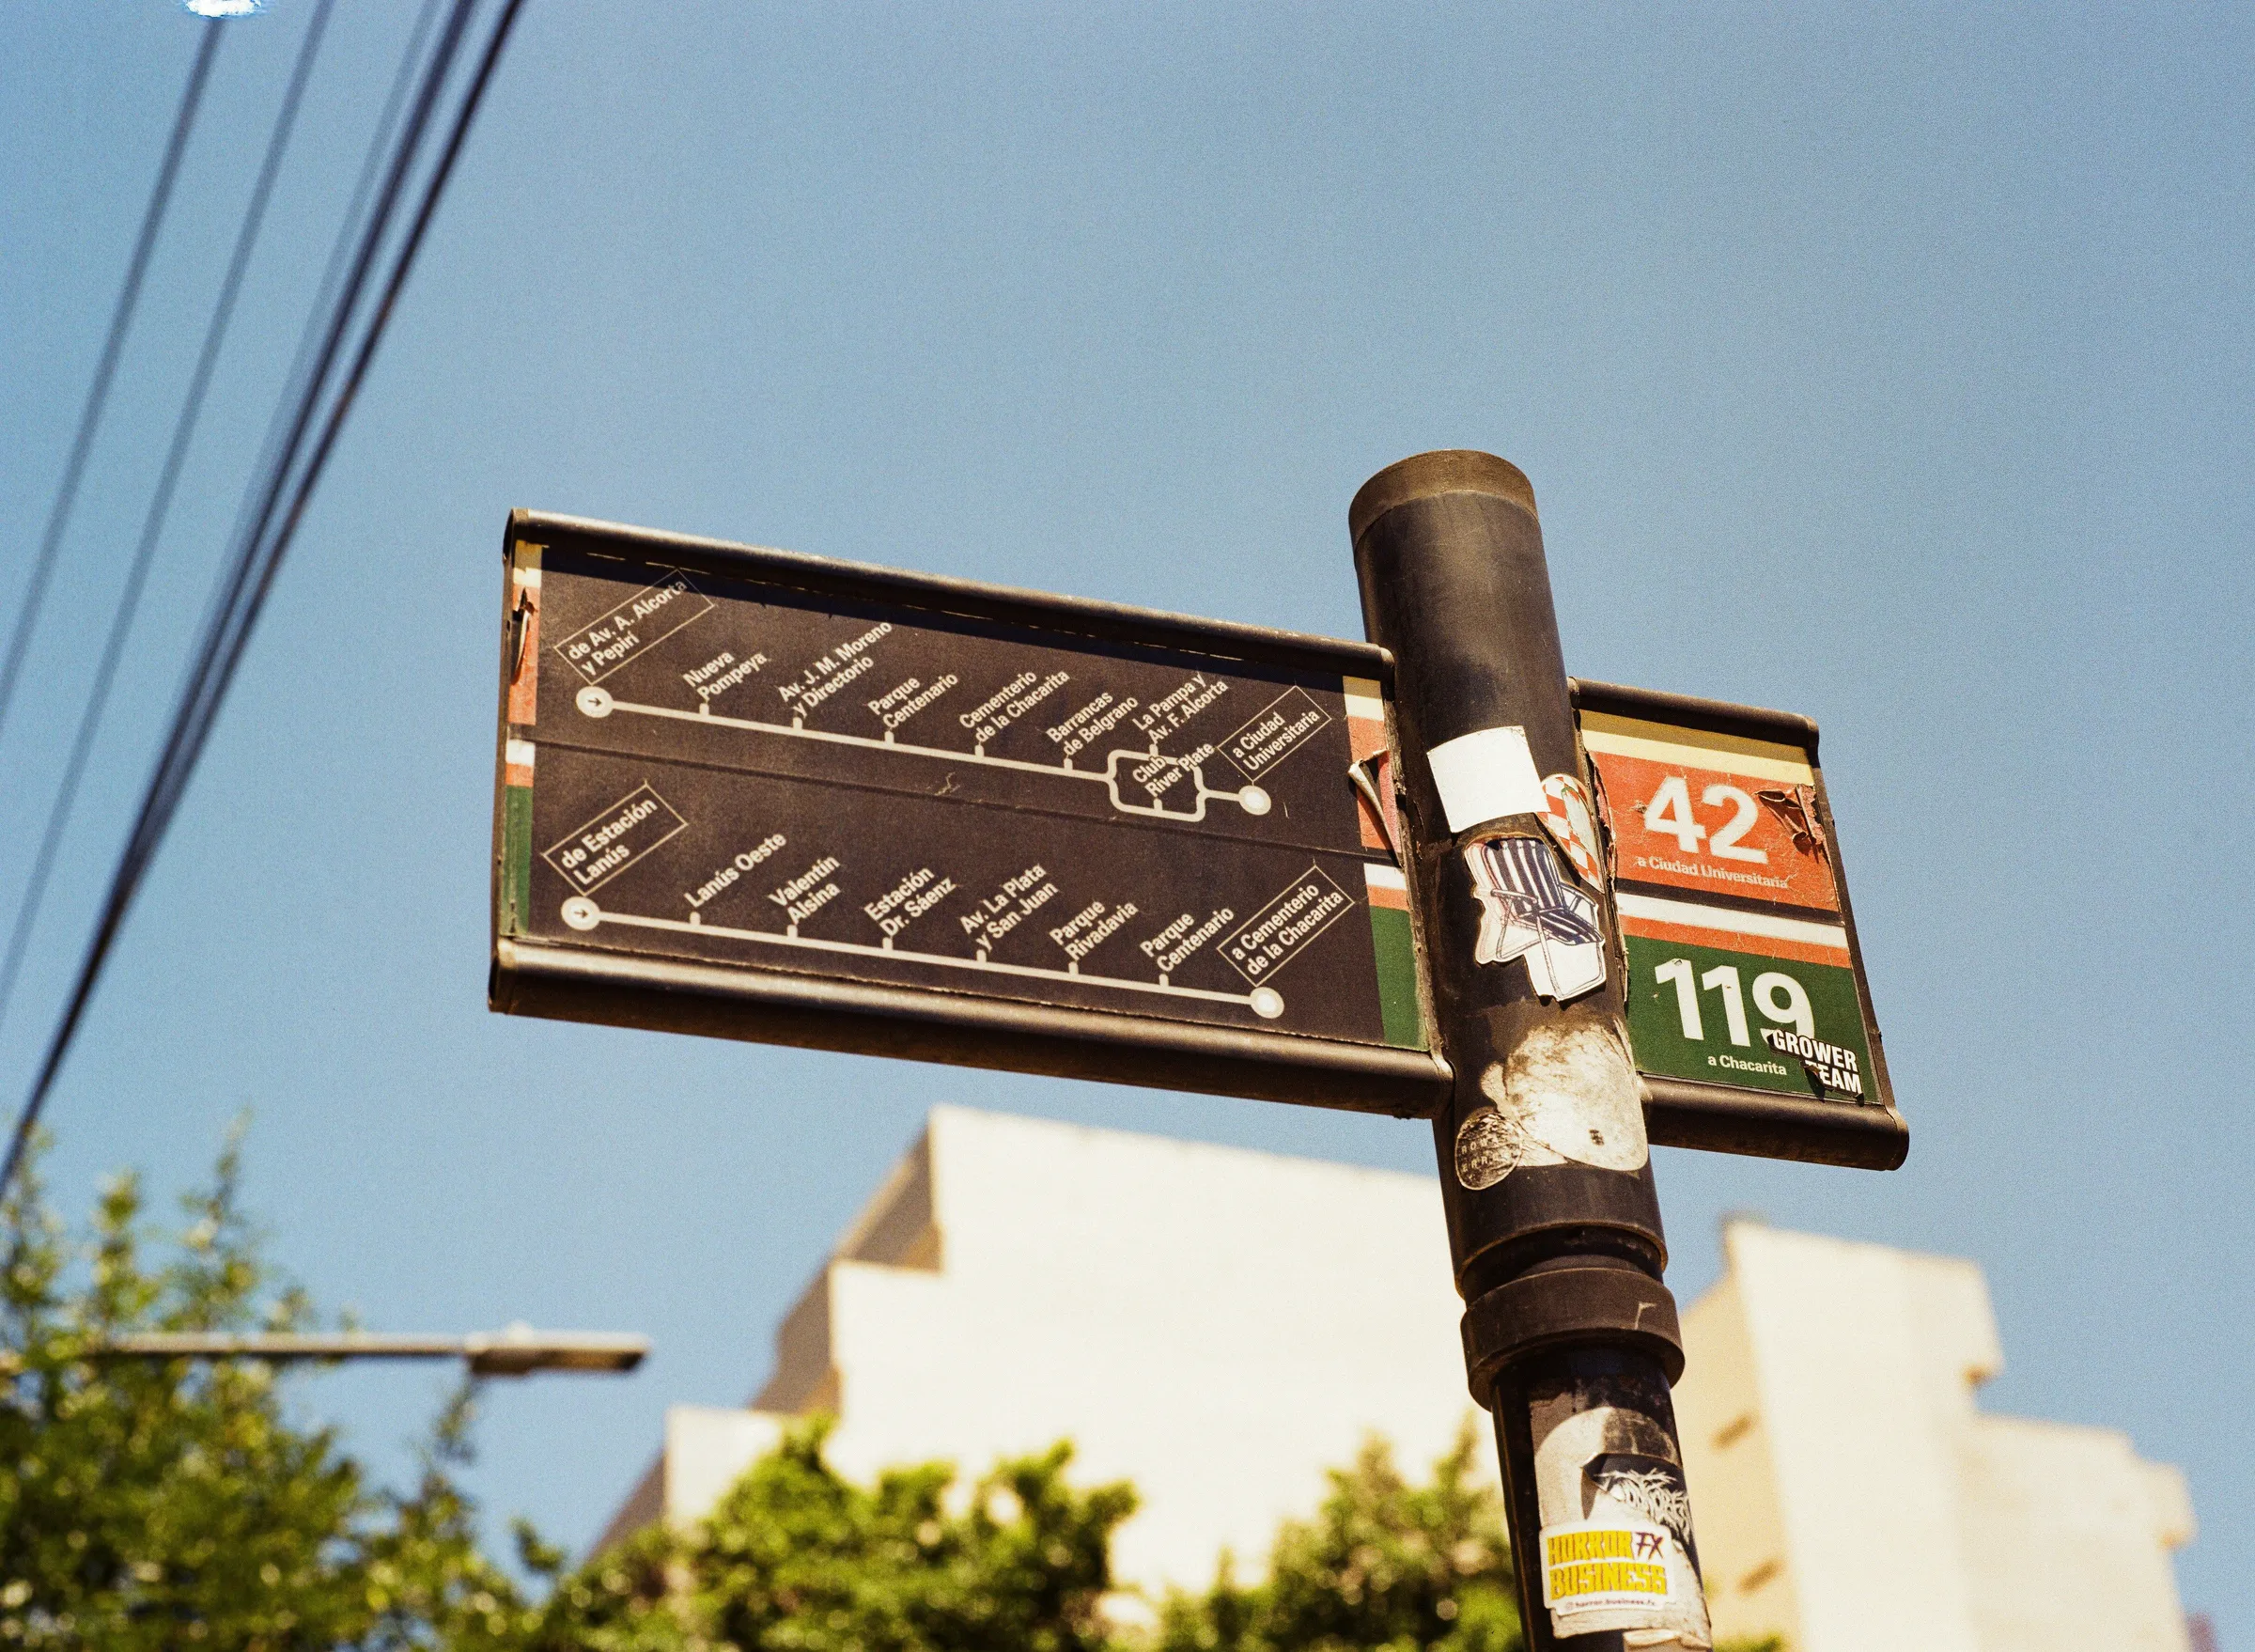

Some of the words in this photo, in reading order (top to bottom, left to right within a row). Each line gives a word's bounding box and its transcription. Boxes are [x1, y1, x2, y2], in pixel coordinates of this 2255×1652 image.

[568, 641, 591, 661] de
[587, 624, 615, 648] Av.
[613, 612, 634, 631] A.
[632, 580, 687, 621] Alcorta
[581, 661, 597, 677] y
[592, 631, 640, 666] Pepirí
[682, 649, 735, 688] Nueva
[697, 651, 767, 701] Pompeya
[777, 678, 806, 703] Av.
[803, 669, 820, 685] J.
[815, 653, 840, 675] M.
[835, 621, 893, 661] Moreno
[792, 703, 807, 718] y
[802, 655, 875, 708] Directorio
[867, 676, 921, 716] Parque
[882, 672, 959, 728] Centenario
[959, 671, 1037, 728] Cementerio
[975, 725, 996, 742] de
[991, 711, 1010, 730] la
[1006, 670, 1070, 719] Chacarita
[1132, 713, 1155, 730] La
[1148, 682, 1196, 717] Pampa
[1191, 671, 1206, 688] y
[1148, 725, 1173, 744] Av.
[1166, 712, 1184, 727] F.
[1180, 680, 1229, 719] Alcorta
[1046, 691, 1113, 743] Barrancas
[1063, 737, 1083, 756] de
[1078, 696, 1139, 745] Belgrano
[1232, 747, 1245, 759] a
[1239, 711, 1285, 752] Ciudad
[1242, 709, 1321, 771] Universitaria
[1132, 756, 1167, 783] Club
[1144, 767, 1183, 797] River
[1176, 743, 1215, 771] Plate
[561, 848, 587, 869] de
[581, 798, 658, 853] Estación
[1644, 775, 1767, 865] 42
[573, 843, 630, 885] Lanús
[684, 865, 740, 908] Lanús
[734, 833, 786, 872] Oeste
[768, 854, 841, 909] Valentín
[1637, 857, 1646, 867] a
[1649, 856, 1699, 876] Ciudad
[1701, 865, 1788, 889] Universitaria
[785, 881, 841, 926] Alsina
[863, 865, 936, 922] Estación
[879, 915, 910, 938] Dr.
[905, 877, 957, 918] Sáenz
[959, 908, 988, 934] Av.
[982, 892, 1008, 913] La
[1003, 864, 1047, 901] Plata
[975, 932, 992, 952] y
[987, 910, 1022, 940] San
[1017, 881, 1059, 916] Juan
[1049, 899, 1106, 945] Parque
[1232, 947, 1246, 960] a
[1240, 884, 1319, 950] Cementerio
[1065, 901, 1139, 961] Rivadavia
[1140, 912, 1195, 958] Parque
[1157, 906, 1235, 973] Centenario
[1247, 958, 1268, 975] de
[1263, 943, 1283, 961] la
[1278, 890, 1344, 946] Chacarita
[1655, 958, 1814, 1048] 119
[1708, 1055, 1717, 1067] a
[1719, 1054, 1787, 1076] Chacarita
[1772, 1029, 1858, 1072] GROWER
[1547, 1531, 1634, 1566] HORROR
[1635, 1532, 1664, 1560] FX
[1548, 1562, 1668, 1600] BUSINESS
